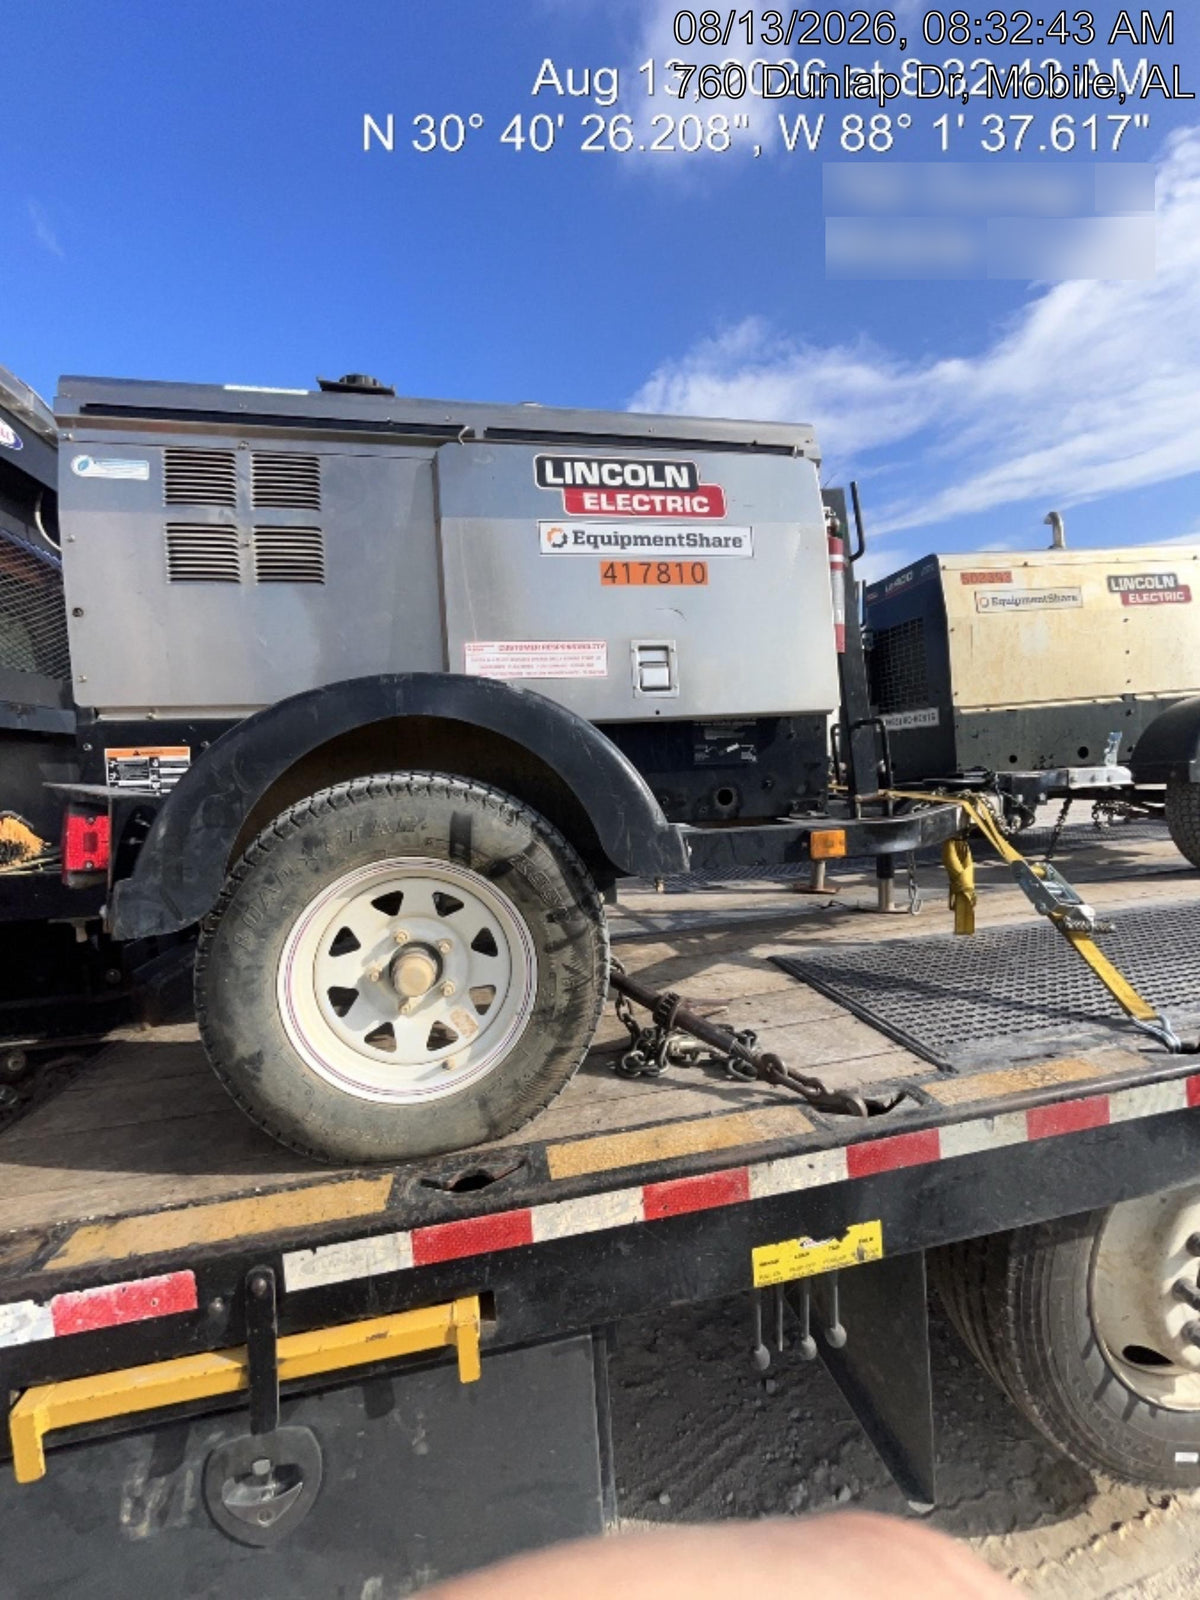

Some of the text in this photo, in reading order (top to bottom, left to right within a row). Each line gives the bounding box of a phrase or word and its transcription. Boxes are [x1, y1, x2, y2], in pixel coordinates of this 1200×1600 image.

[545, 460, 690, 488] LINCOLN
[583, 492, 709, 514] ELECTRIC
[572, 530, 743, 549] EquipmentShare
[603, 561, 706, 585] 417810
[1110, 575, 1175, 592] LINCOLN
[990, 593, 1078, 607] EquipmentShare
[1128, 591, 1185, 604] ELECTRIC
